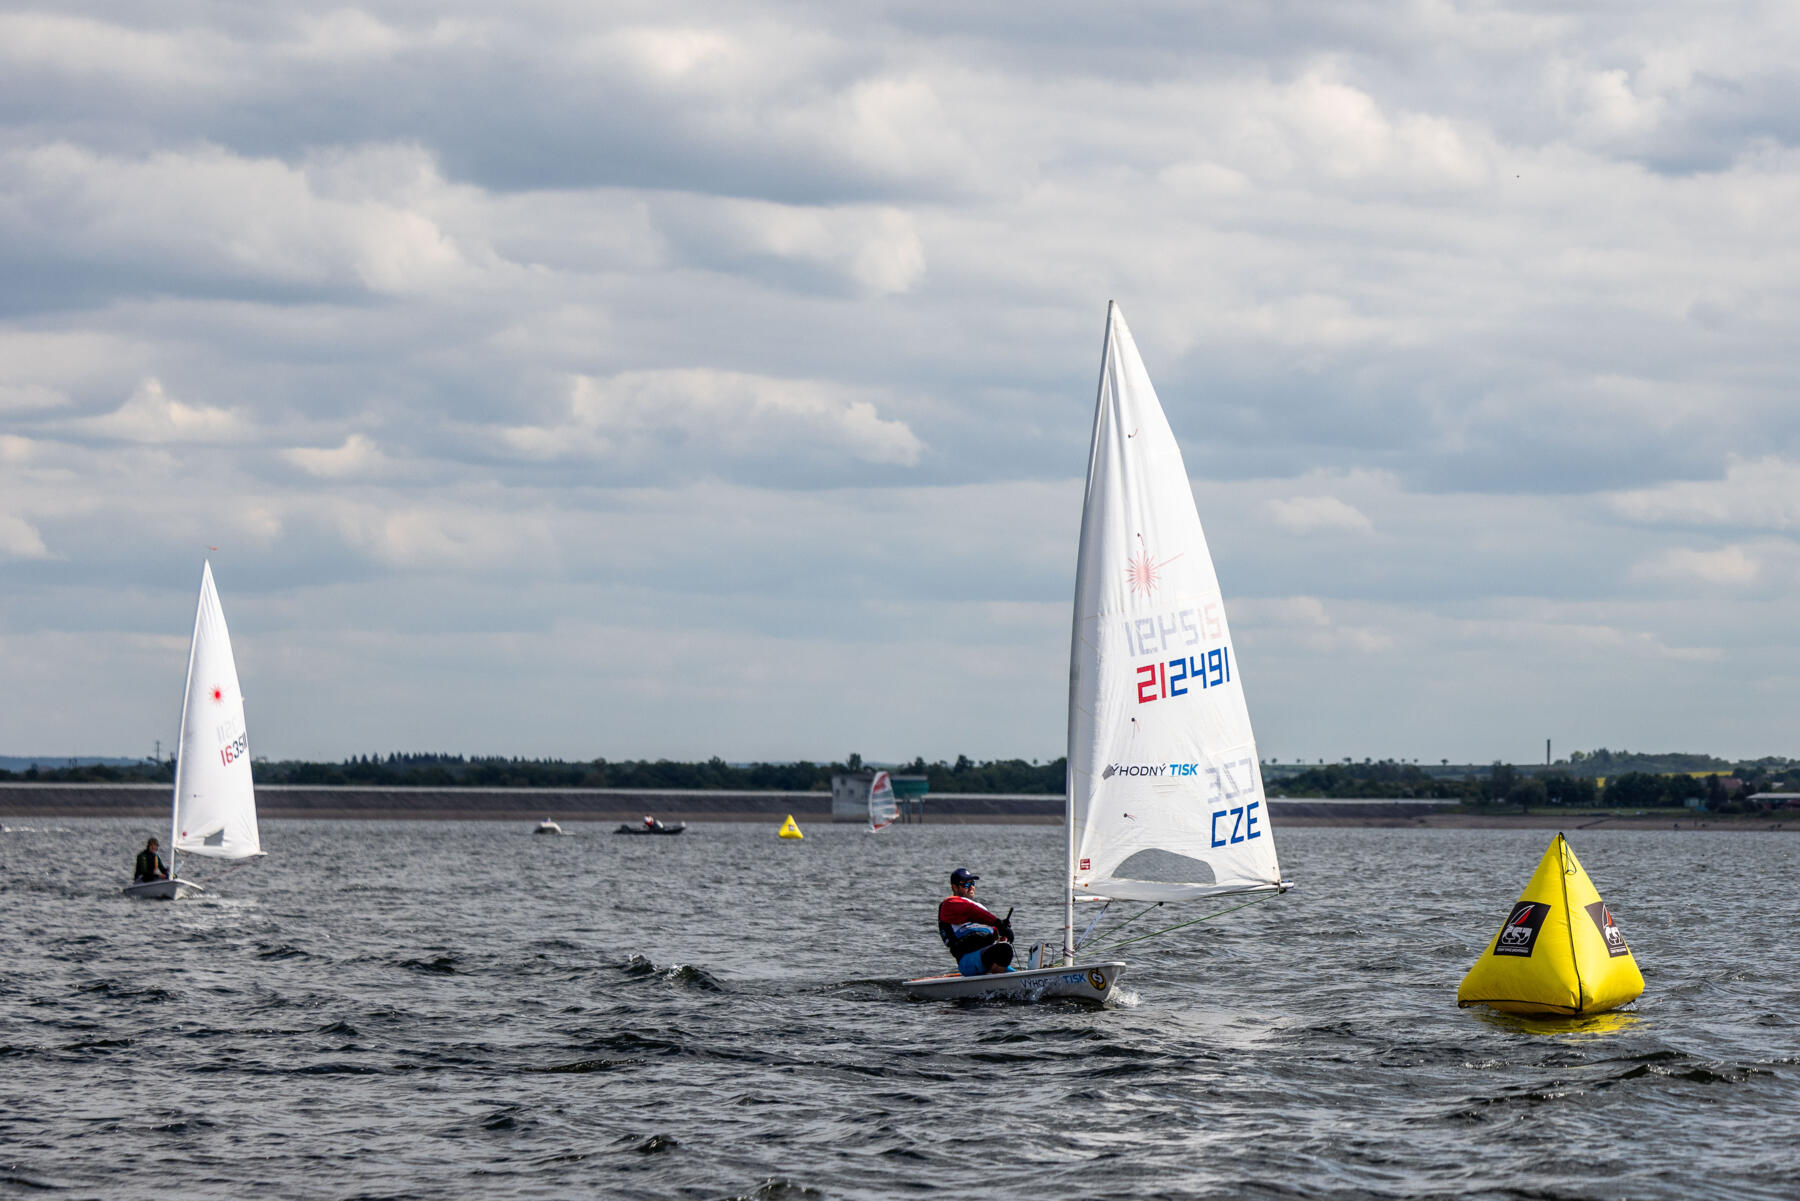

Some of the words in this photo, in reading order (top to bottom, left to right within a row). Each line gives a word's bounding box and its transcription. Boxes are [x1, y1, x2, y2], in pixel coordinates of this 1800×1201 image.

[1136, 647, 1230, 704] 212491
[1103, 763, 1167, 778] ÝHODNÝ
[1169, 763, 1198, 776] TISK
[1211, 801, 1261, 848] CZE
[1062, 973, 1087, 984] TISK
